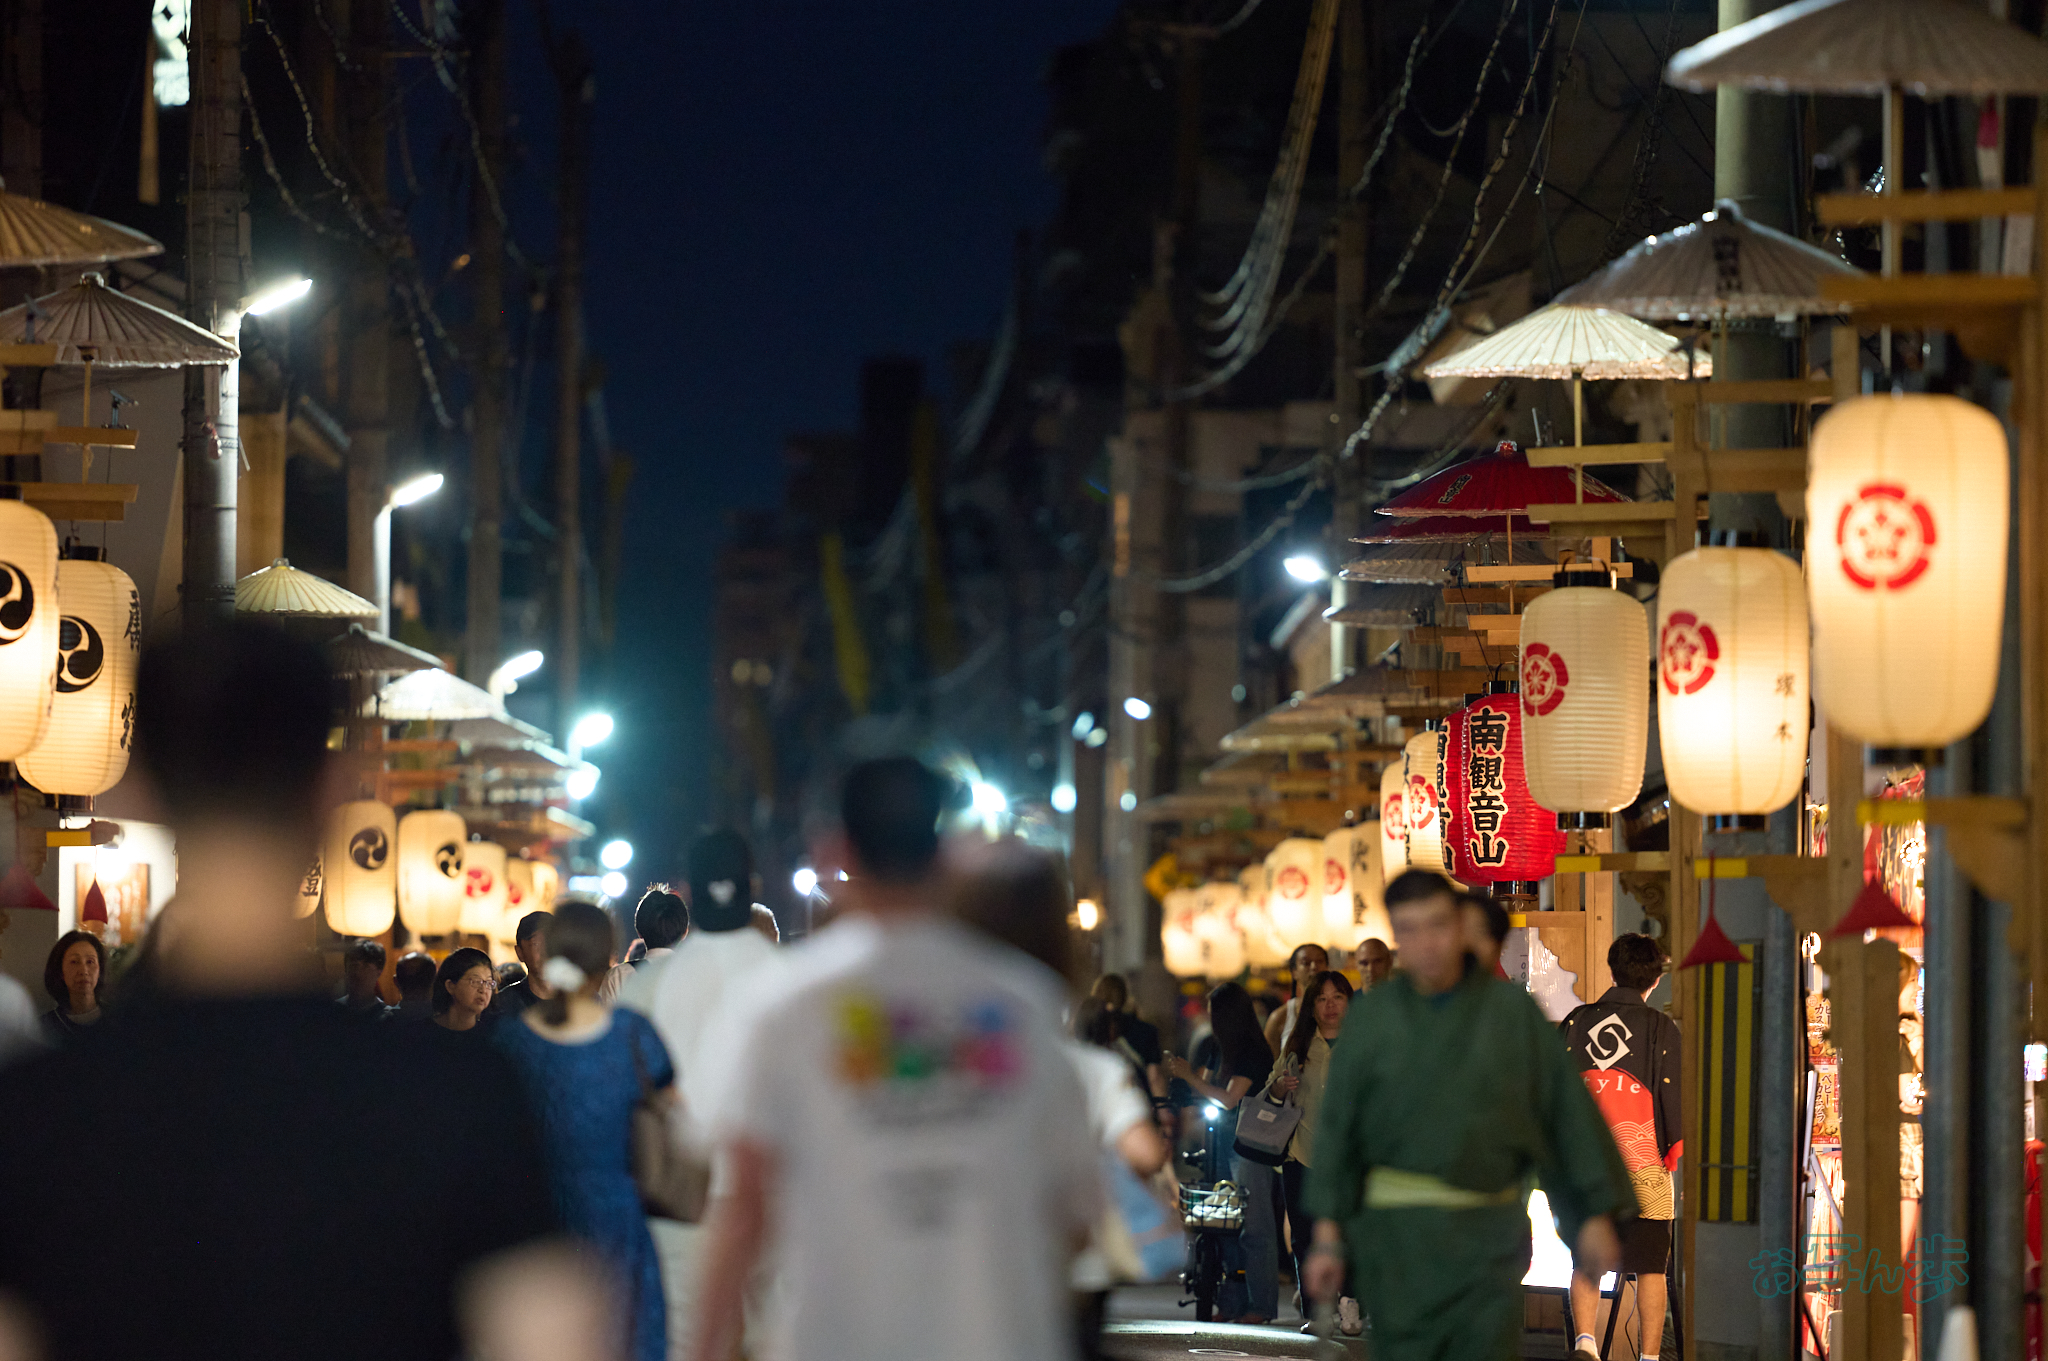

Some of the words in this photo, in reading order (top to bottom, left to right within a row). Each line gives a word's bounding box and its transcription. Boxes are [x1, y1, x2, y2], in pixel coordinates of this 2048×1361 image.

[1469, 705, 1509, 867] 南観音山
[1821, 1074, 1832, 1108] ベビー
